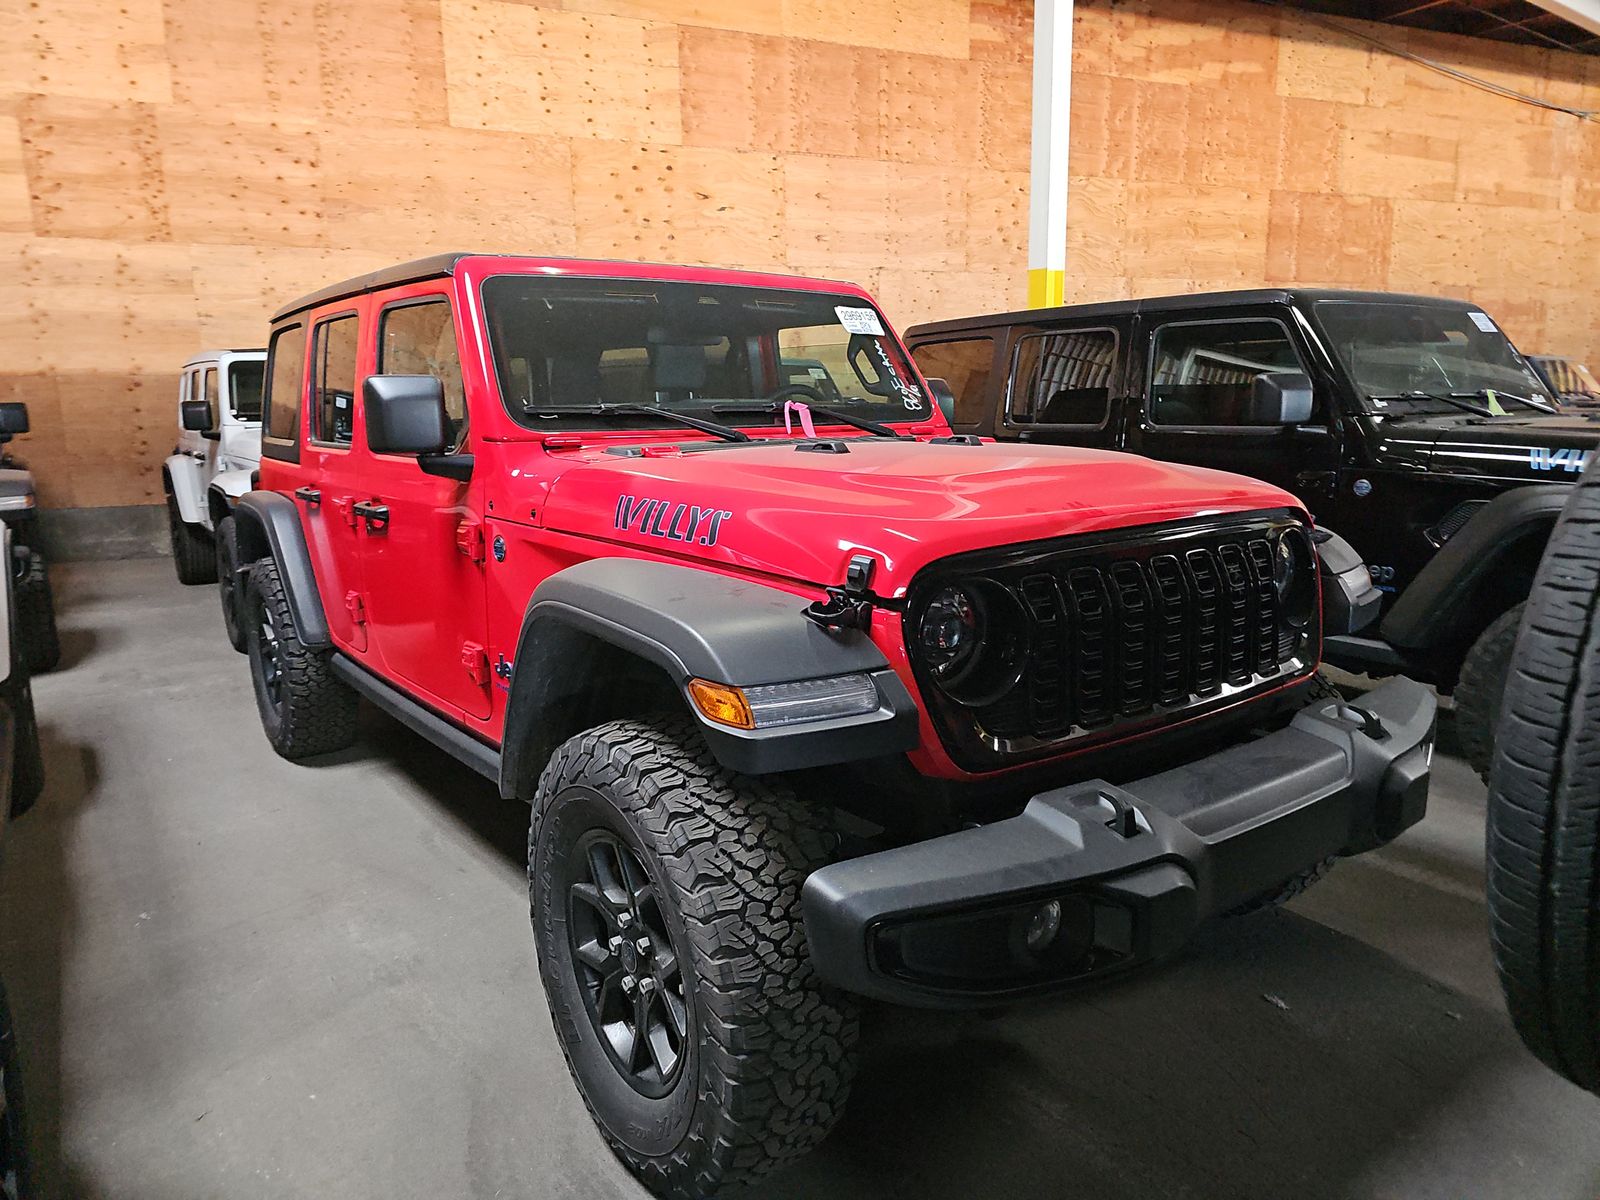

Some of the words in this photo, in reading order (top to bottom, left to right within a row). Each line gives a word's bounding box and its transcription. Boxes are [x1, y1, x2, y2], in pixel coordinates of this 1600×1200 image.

[840, 310, 877, 321] 2969156
[614, 494, 733, 547] WILLYS
[1369, 564, 1395, 582] ep
